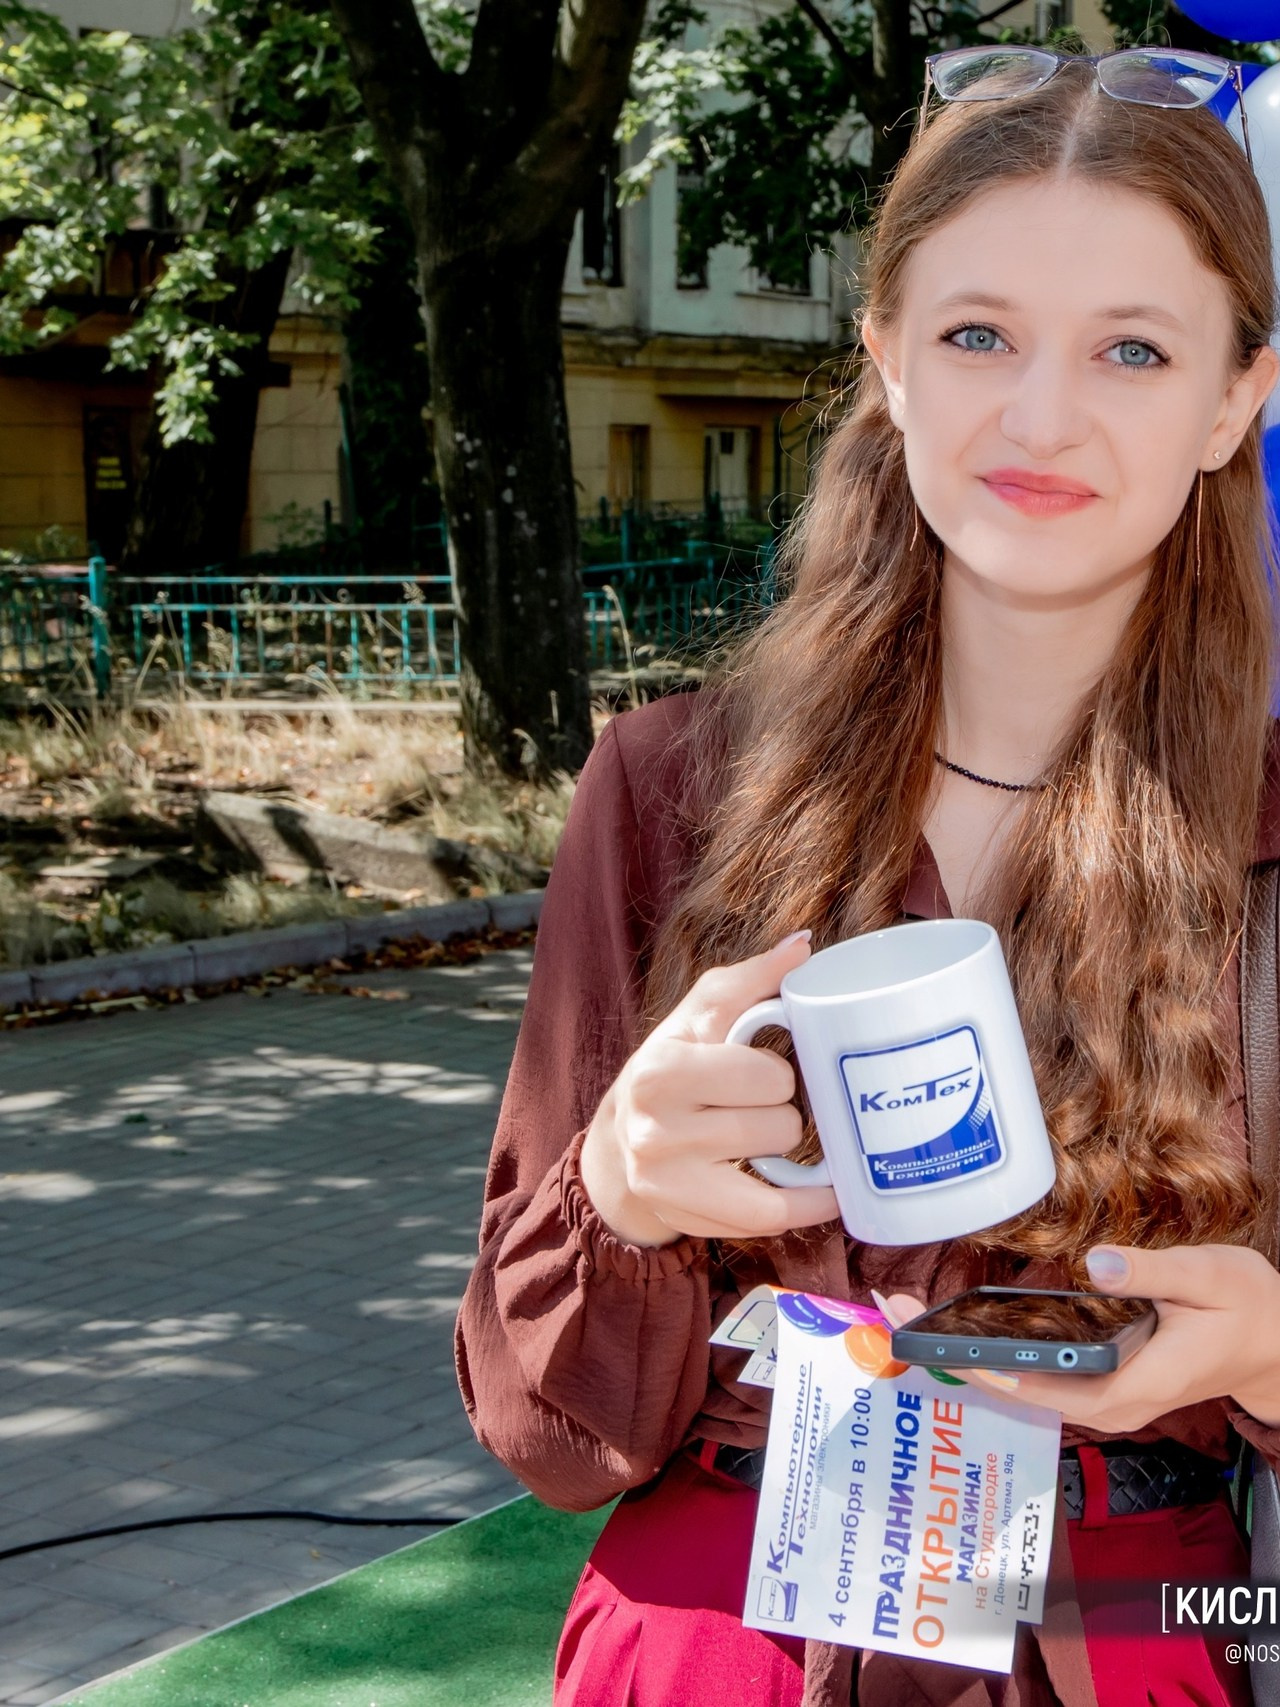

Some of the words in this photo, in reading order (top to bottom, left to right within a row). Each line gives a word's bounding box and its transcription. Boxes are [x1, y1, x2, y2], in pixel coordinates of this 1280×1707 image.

[860, 1066, 973, 1113] КомТех
[874, 1138, 992, 1172] Компьютерные
[879, 1149, 988, 1181] Технологии
[817, 1403, 831, 1472] электроники
[849, 1388, 873, 1448] 10:00
[767, 1363, 807, 1573] Компьютерные
[786, 1374, 822, 1563] Технологии
[852, 1459, 867, 1474] в
[1004, 1453, 1015, 1474] 98д
[810, 1473, 825, 1530] магазины
[872, 1391, 922, 1640] ПРАЗДНИЧНОЕ
[912, 1397, 964, 1648] ОТКРЫТИЕ
[956, 1463, 982, 1584] МАГАЗИНА!
[975, 1453, 999, 1579] Студгородке
[1001, 1478, 1014, 1528] Артема,
[835, 1481, 867, 1604] сентября
[1001, 1530, 1011, 1550] ул.
[975, 1587, 988, 1609] на
[994, 1554, 1008, 1605] Донецк,
[829, 1612, 847, 1627] 4
